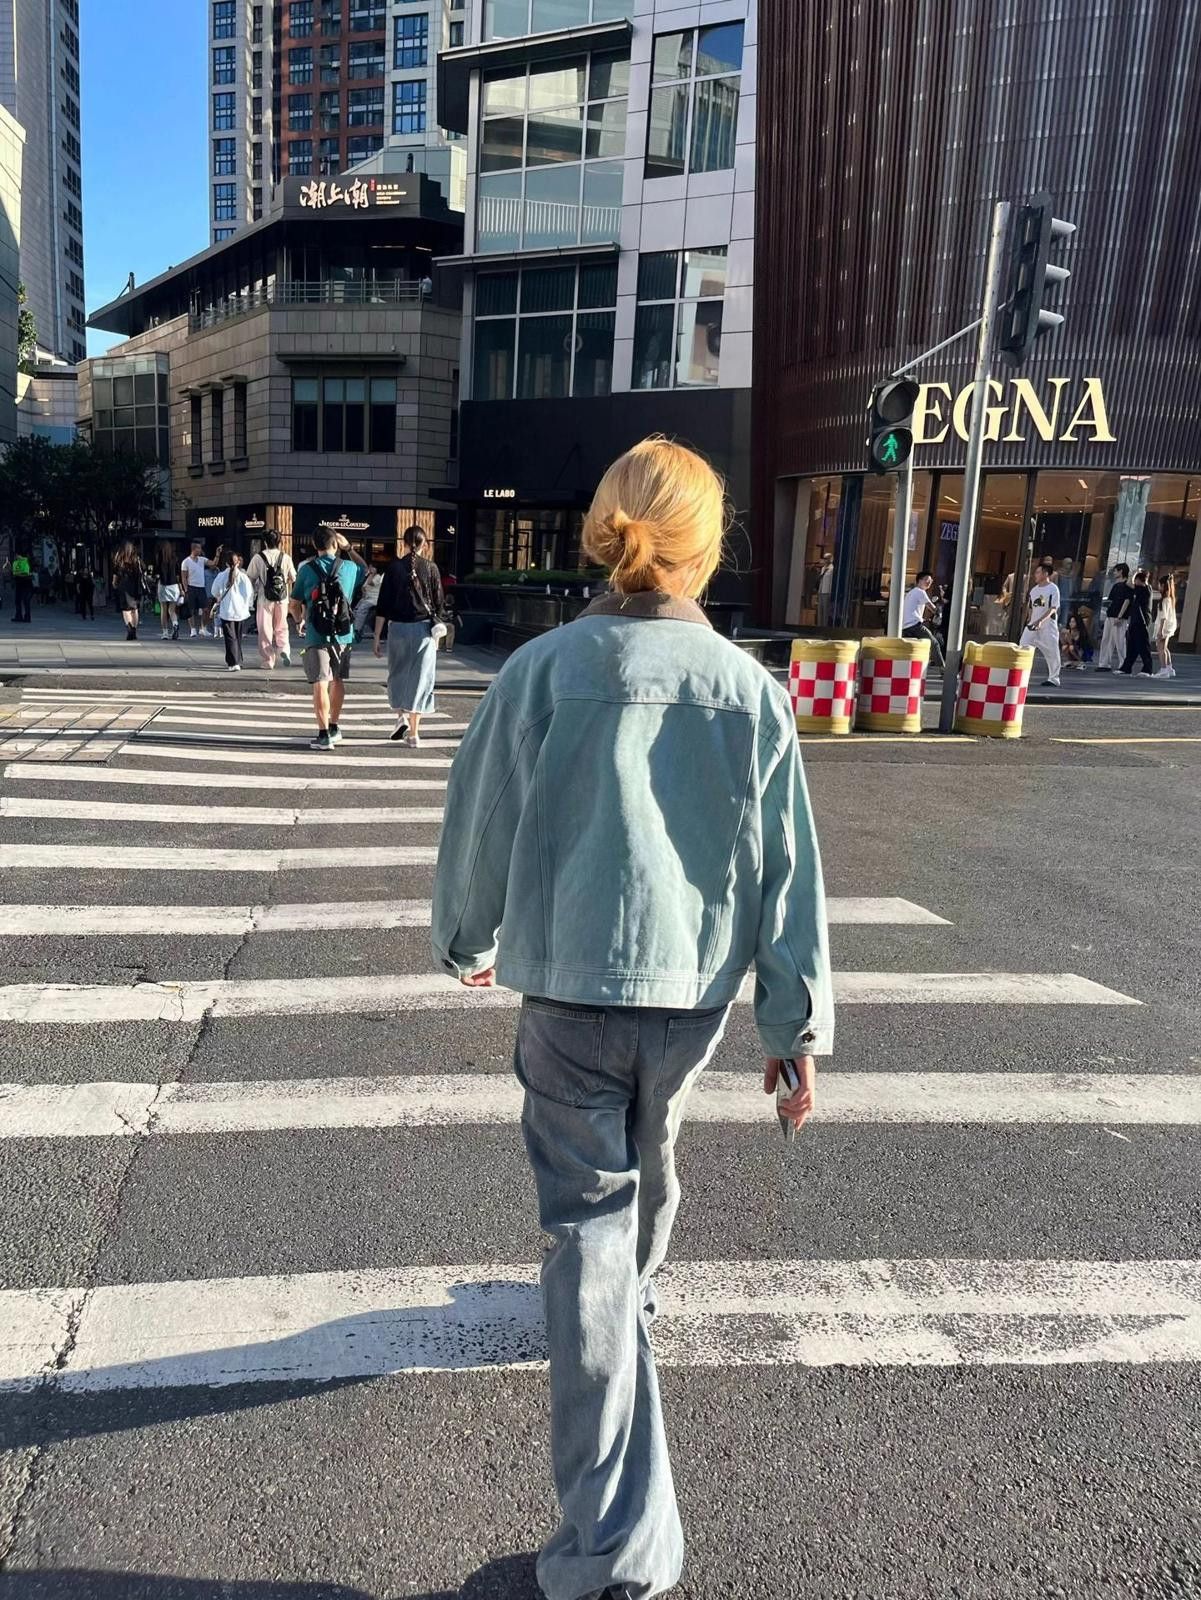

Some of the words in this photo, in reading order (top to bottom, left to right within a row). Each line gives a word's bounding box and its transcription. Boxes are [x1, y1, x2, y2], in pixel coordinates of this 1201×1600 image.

[867, 378, 1117, 446] EGNA
[484, 489, 494, 498] LE
[495, 489, 515, 498] LABO
[198, 516, 224, 527] PANERAI
[941, 522, 960, 540] ZEG
